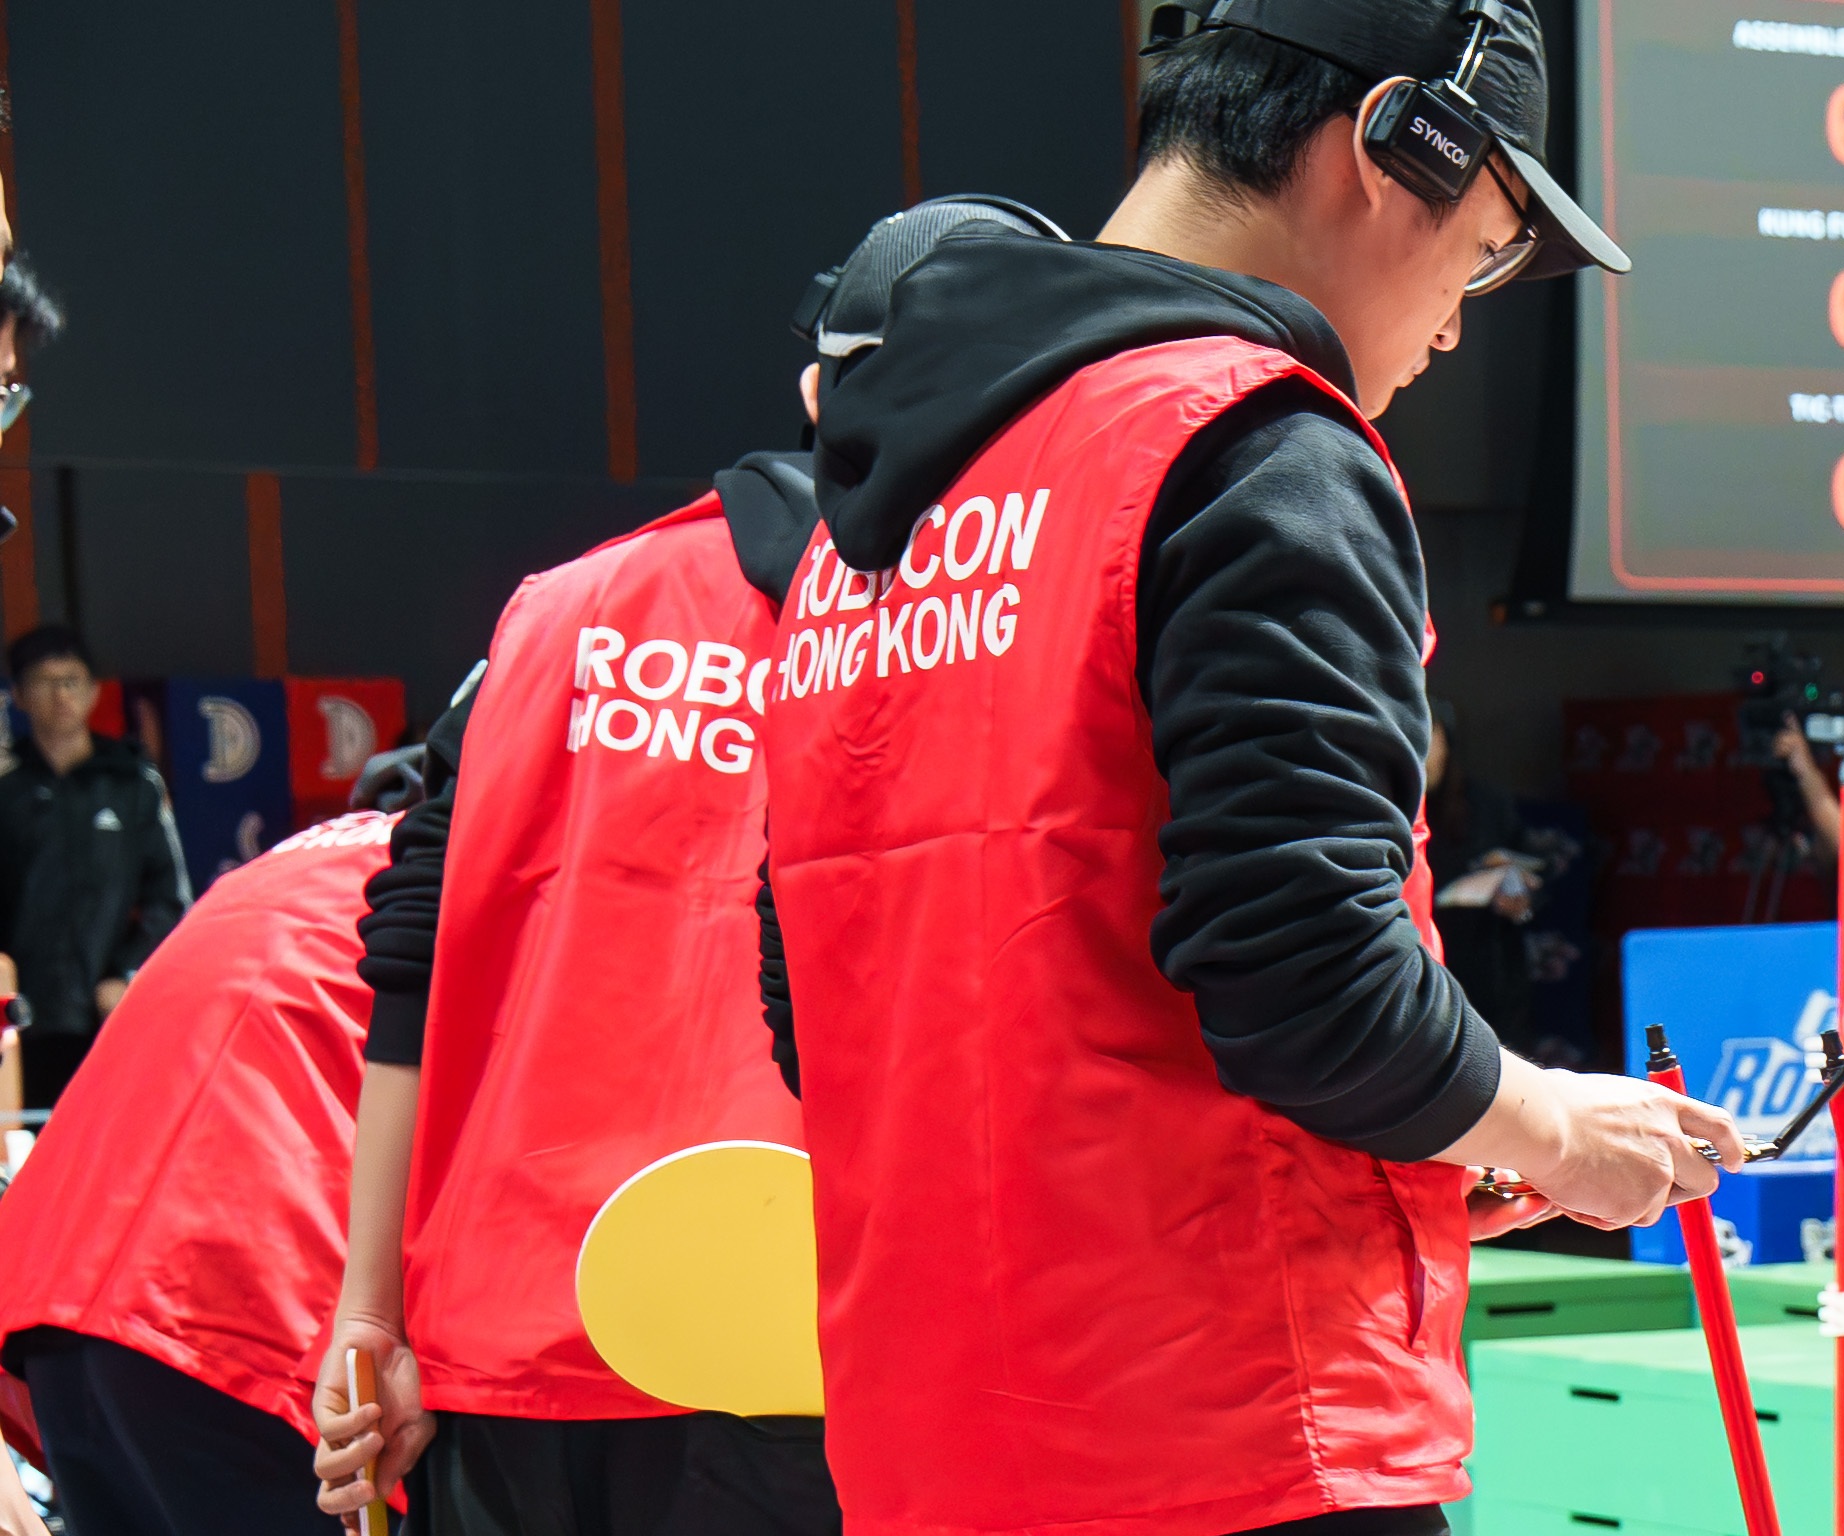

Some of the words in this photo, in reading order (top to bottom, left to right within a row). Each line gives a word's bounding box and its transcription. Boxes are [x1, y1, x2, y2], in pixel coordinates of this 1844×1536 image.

[1410, 116, 1466, 166] SYNCO
[1758, 207, 1826, 240] KUNG
[876, 583, 1021, 678] KONG
[566, 694, 756, 774] HONG
